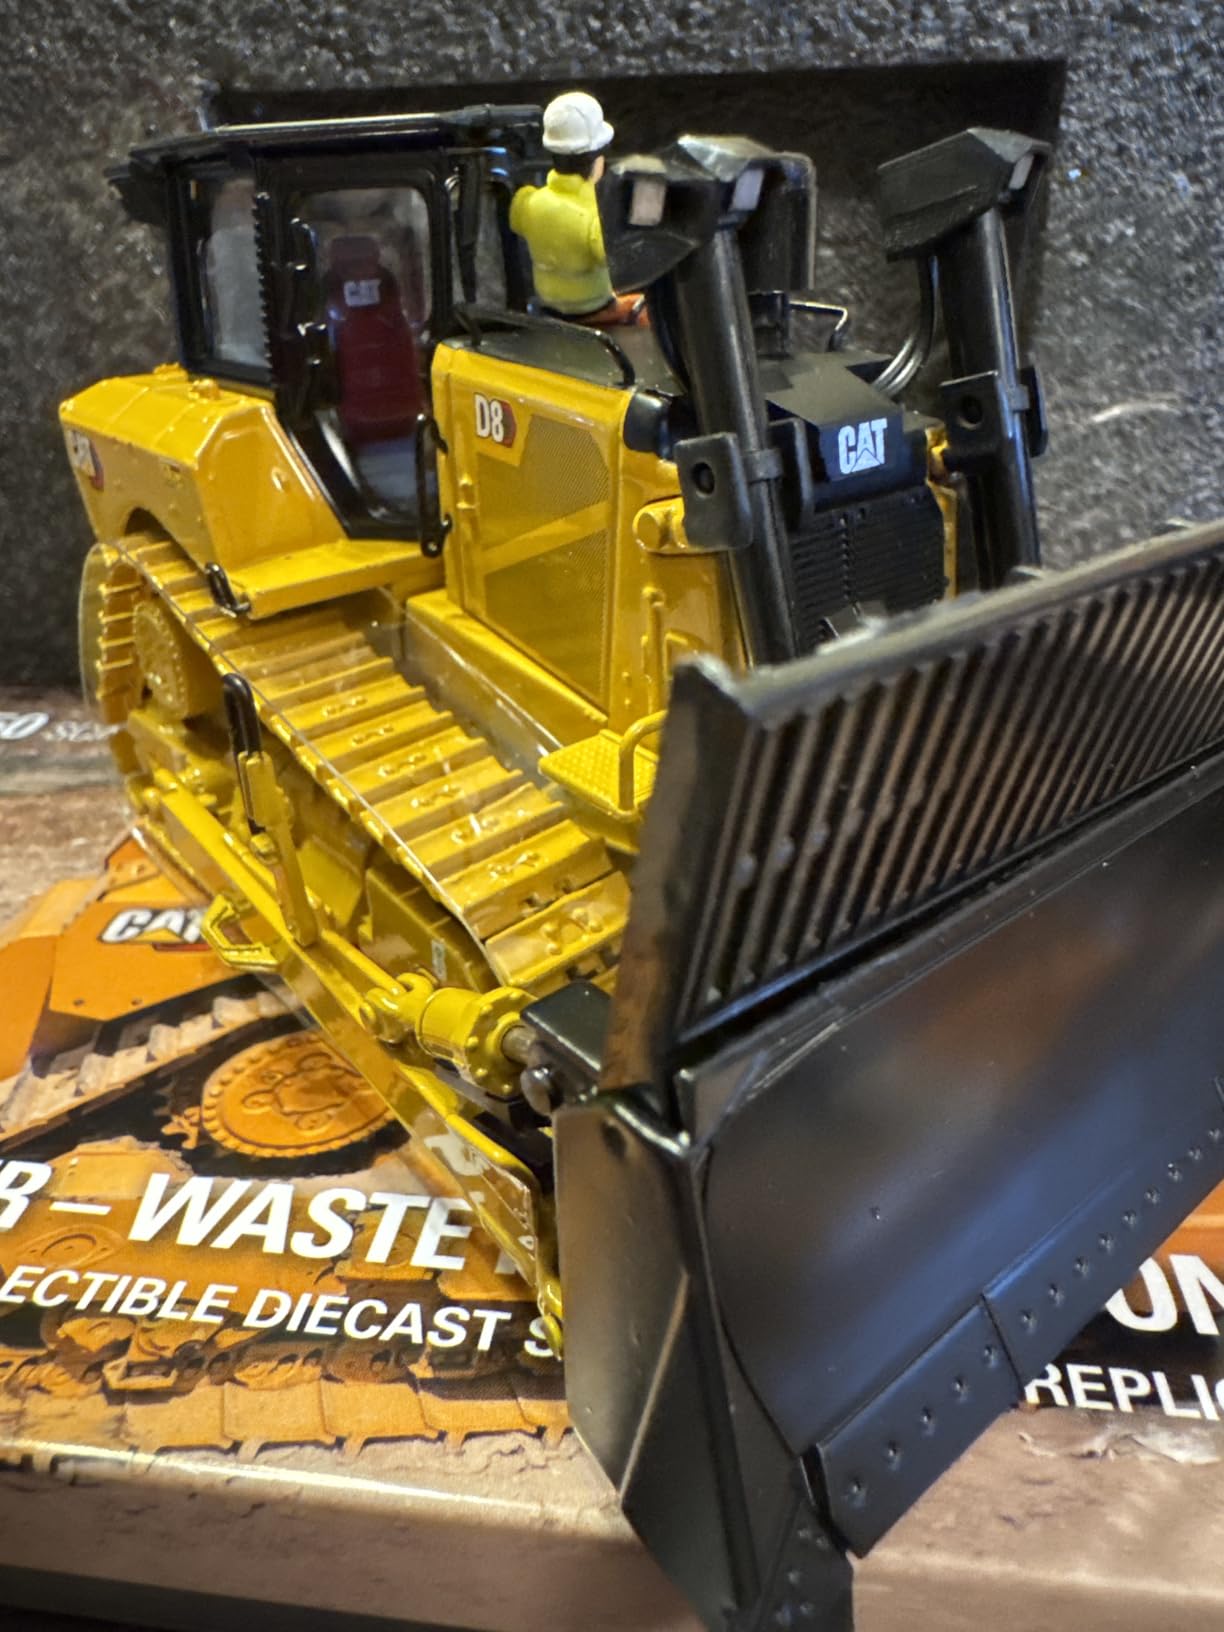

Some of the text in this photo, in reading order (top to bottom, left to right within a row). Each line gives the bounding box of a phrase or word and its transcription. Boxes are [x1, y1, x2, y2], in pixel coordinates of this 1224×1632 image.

[474, 392, 504, 443] D8
[838, 417, 888, 474] CAT
[127, 1172, 472, 1270] WASTE
[0, 1265, 237, 1323] ECTIBLE
[242, 1290, 511, 1352] DIECAST
